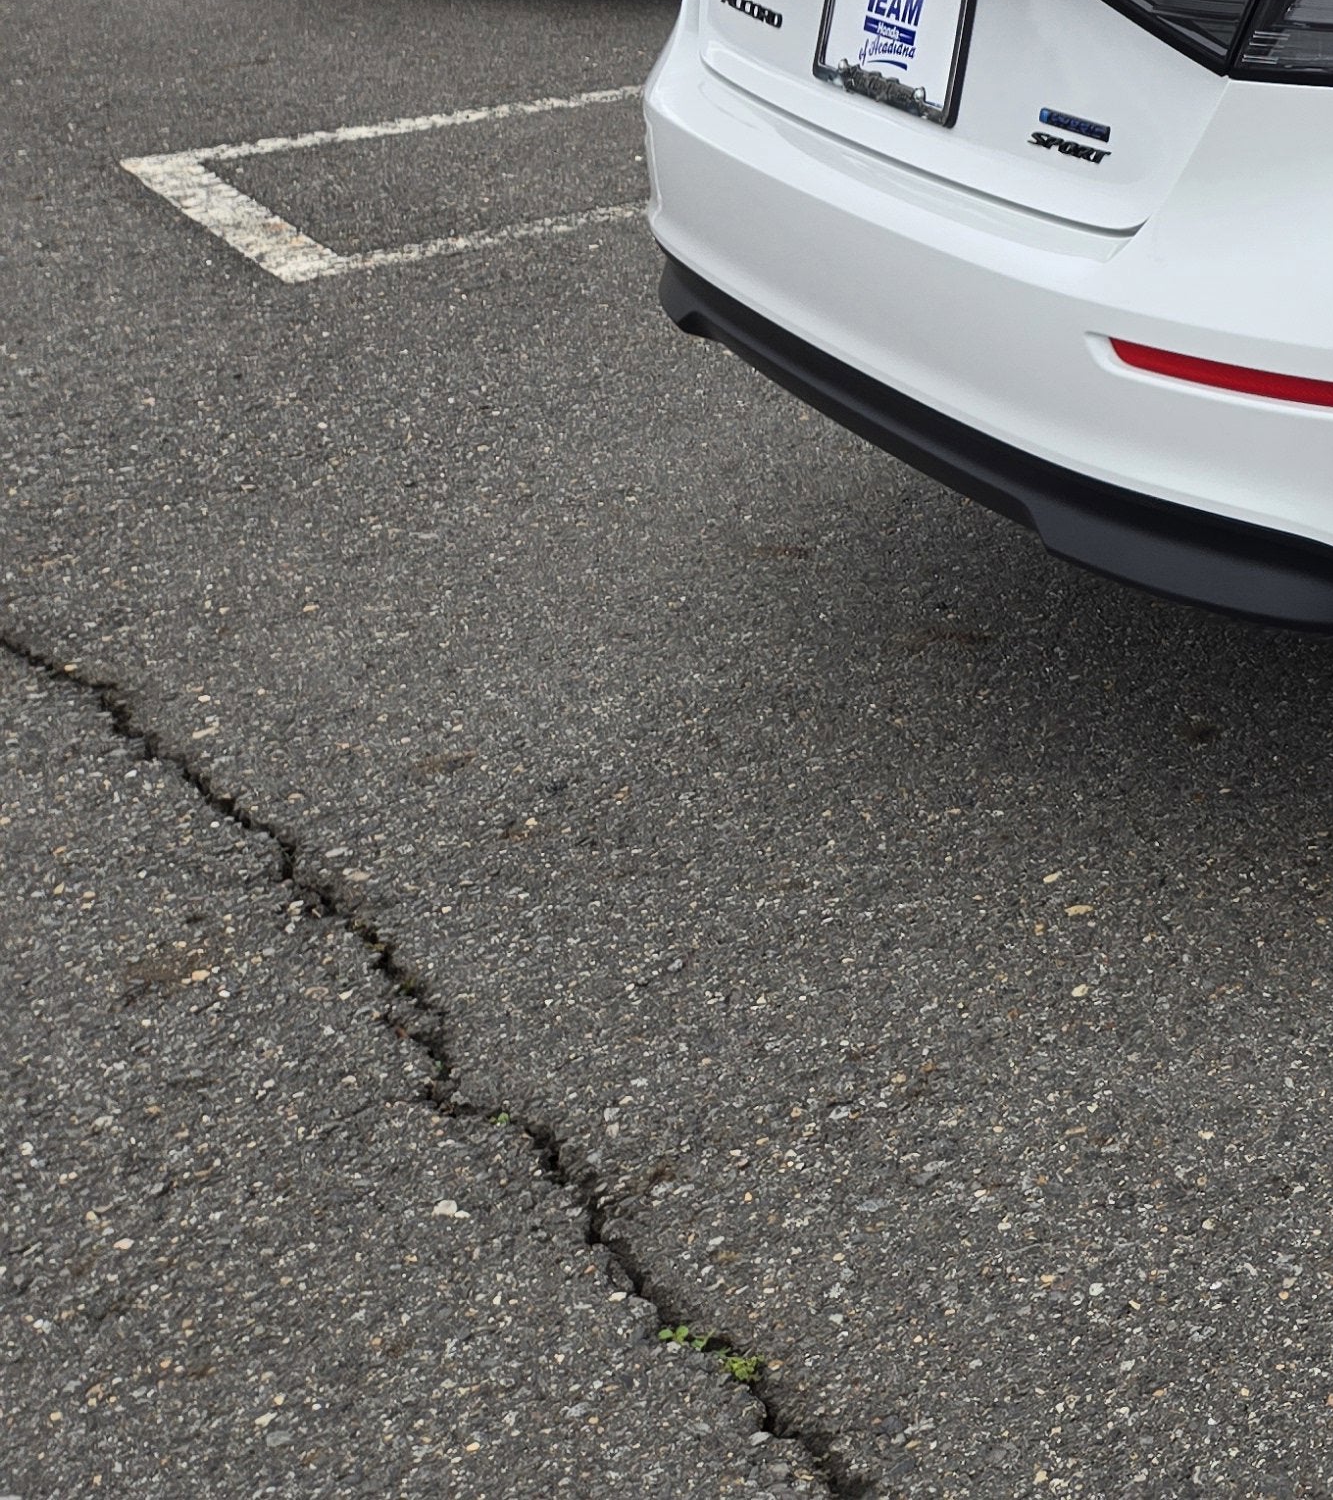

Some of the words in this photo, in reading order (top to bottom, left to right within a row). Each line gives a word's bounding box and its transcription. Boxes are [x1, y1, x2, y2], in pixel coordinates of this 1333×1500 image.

[876, 21, 900, 40] Honda
[859, 38, 869, 66] of
[868, 37, 917, 60] Acadiana
[1027, 132, 1112, 165] SPORT
